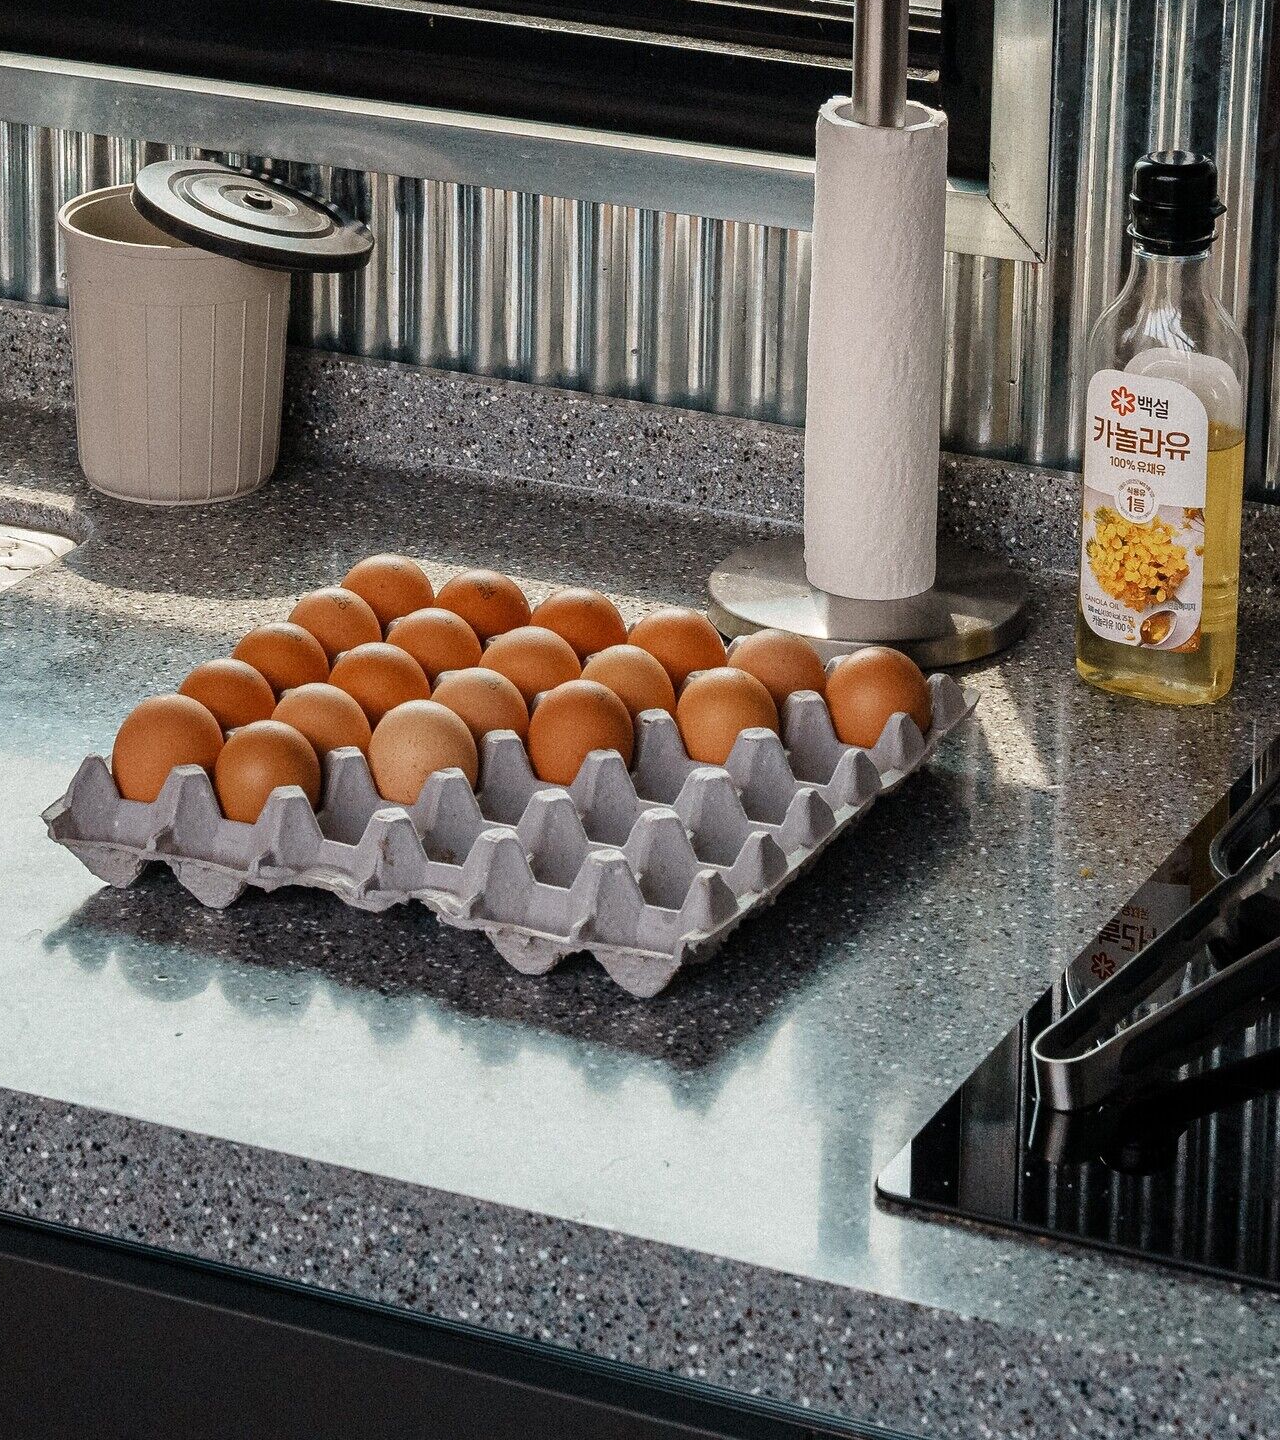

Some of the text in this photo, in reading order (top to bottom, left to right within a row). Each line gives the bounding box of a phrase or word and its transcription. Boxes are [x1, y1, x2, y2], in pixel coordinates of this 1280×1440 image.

[1137, 395, 1169, 420] 백설
[1093, 415, 1191, 462] 카놀라유
[1109, 455, 1167, 476] 100% 유채유
[1126, 495, 1145, 513] 1등
[1084, 593, 1120, 611] CANOLA OIL
[1115, 621, 1126, 632] 100
